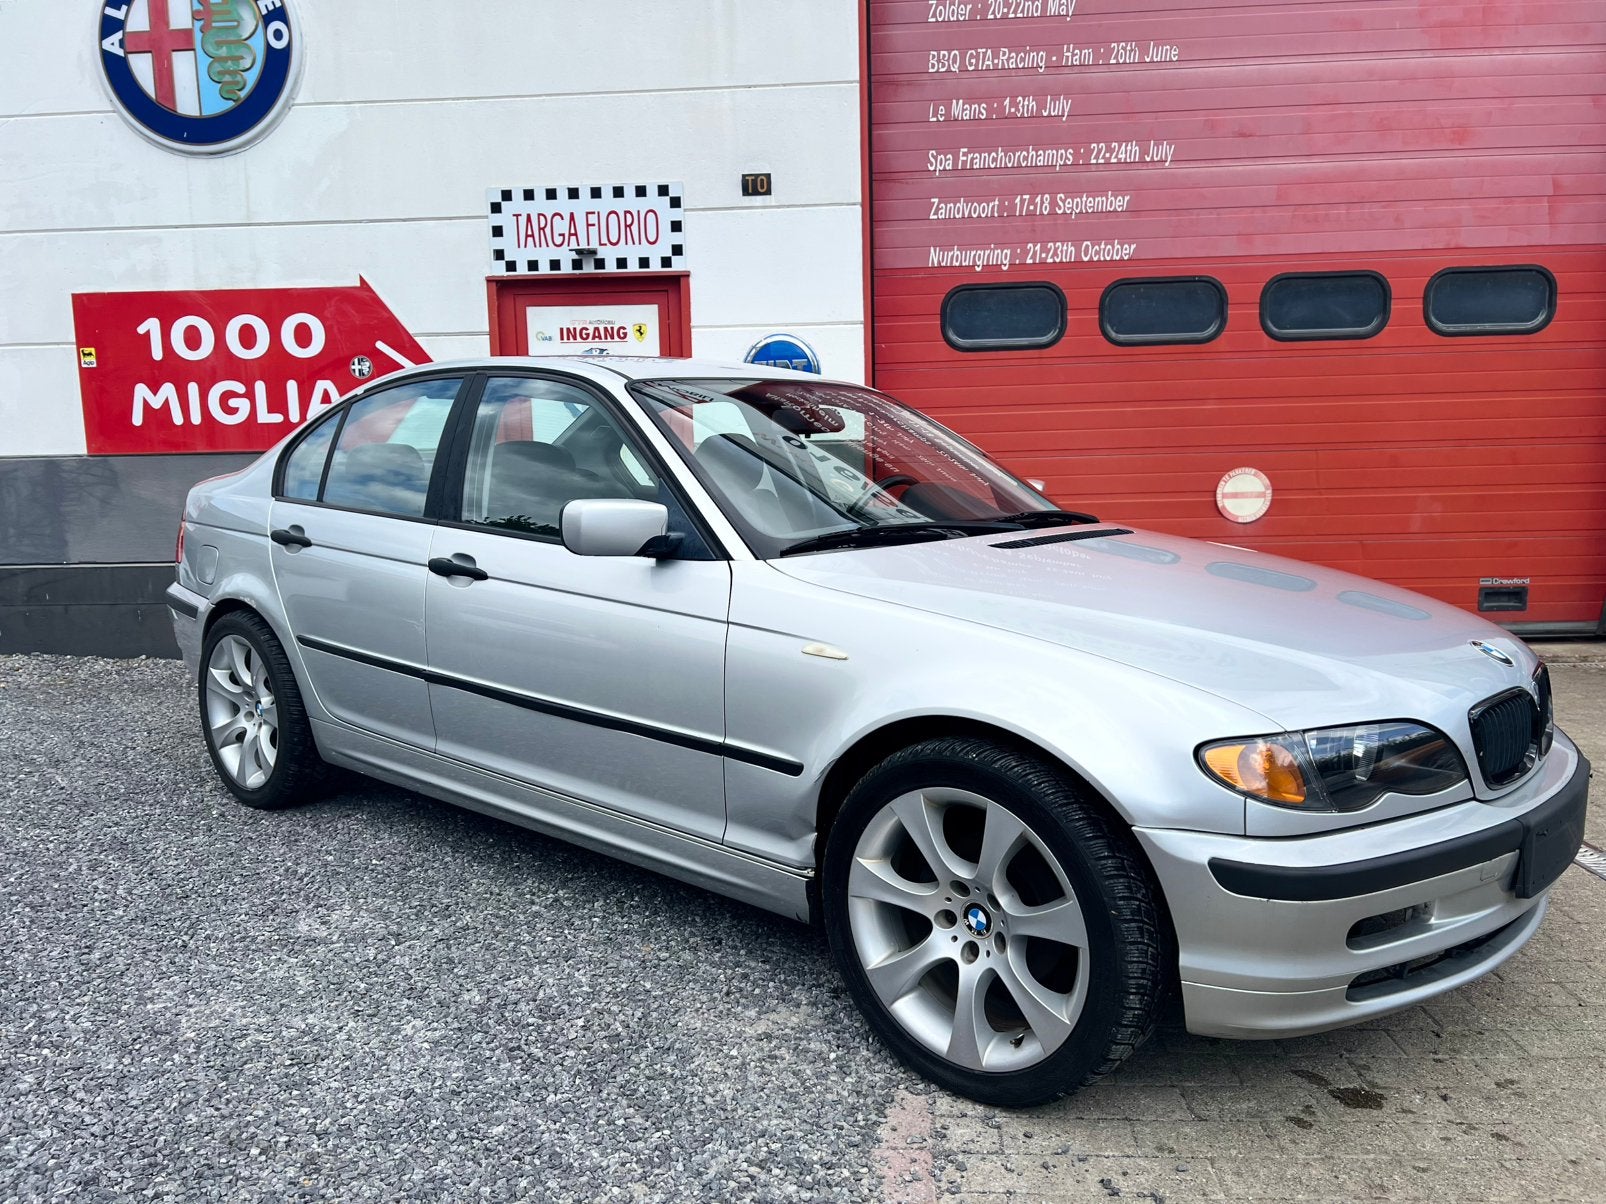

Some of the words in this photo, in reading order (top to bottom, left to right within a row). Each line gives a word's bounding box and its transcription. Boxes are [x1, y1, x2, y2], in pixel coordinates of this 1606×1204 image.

[928, 0, 972, 22] Zolder
[987, 0, 1041, 19] 20-22nd
[1047, 0, 1076, 21] May
[928, 50, 960, 73] BBQ
[966, 46, 1046, 72] GTA-Racing
[1062, 44, 1093, 66] Ham
[1110, 42, 1139, 64] 26th
[1144, 41, 1179, 62] June
[929, 102, 945, 121] Le
[951, 99, 987, 120] Mans
[1003, 95, 1037, 118] 1-3th
[1042, 94, 1072, 121] July
[928, 150, 953, 175] Spa
[958, 146, 1074, 170] Franchorchamps
[1090, 141, 1140, 164] 22-24th
[1145, 140, 1175, 166] July
[929, 198, 999, 220] Zandvoort
[1014, 194, 1050, 216] 17-18
[1056, 191, 1130, 218] September
[512, 211, 580, 248] TARGA
[585, 208, 660, 247] FLORIO
[929, 244, 1011, 271] Nurburgring
[1027, 242, 1075, 264] 21-23th
[1081, 239, 1136, 262] October
[136, 312, 326, 362] 1000
[560, 326, 628, 341] INGANG
[131, 379, 340, 427] MIGLIA
